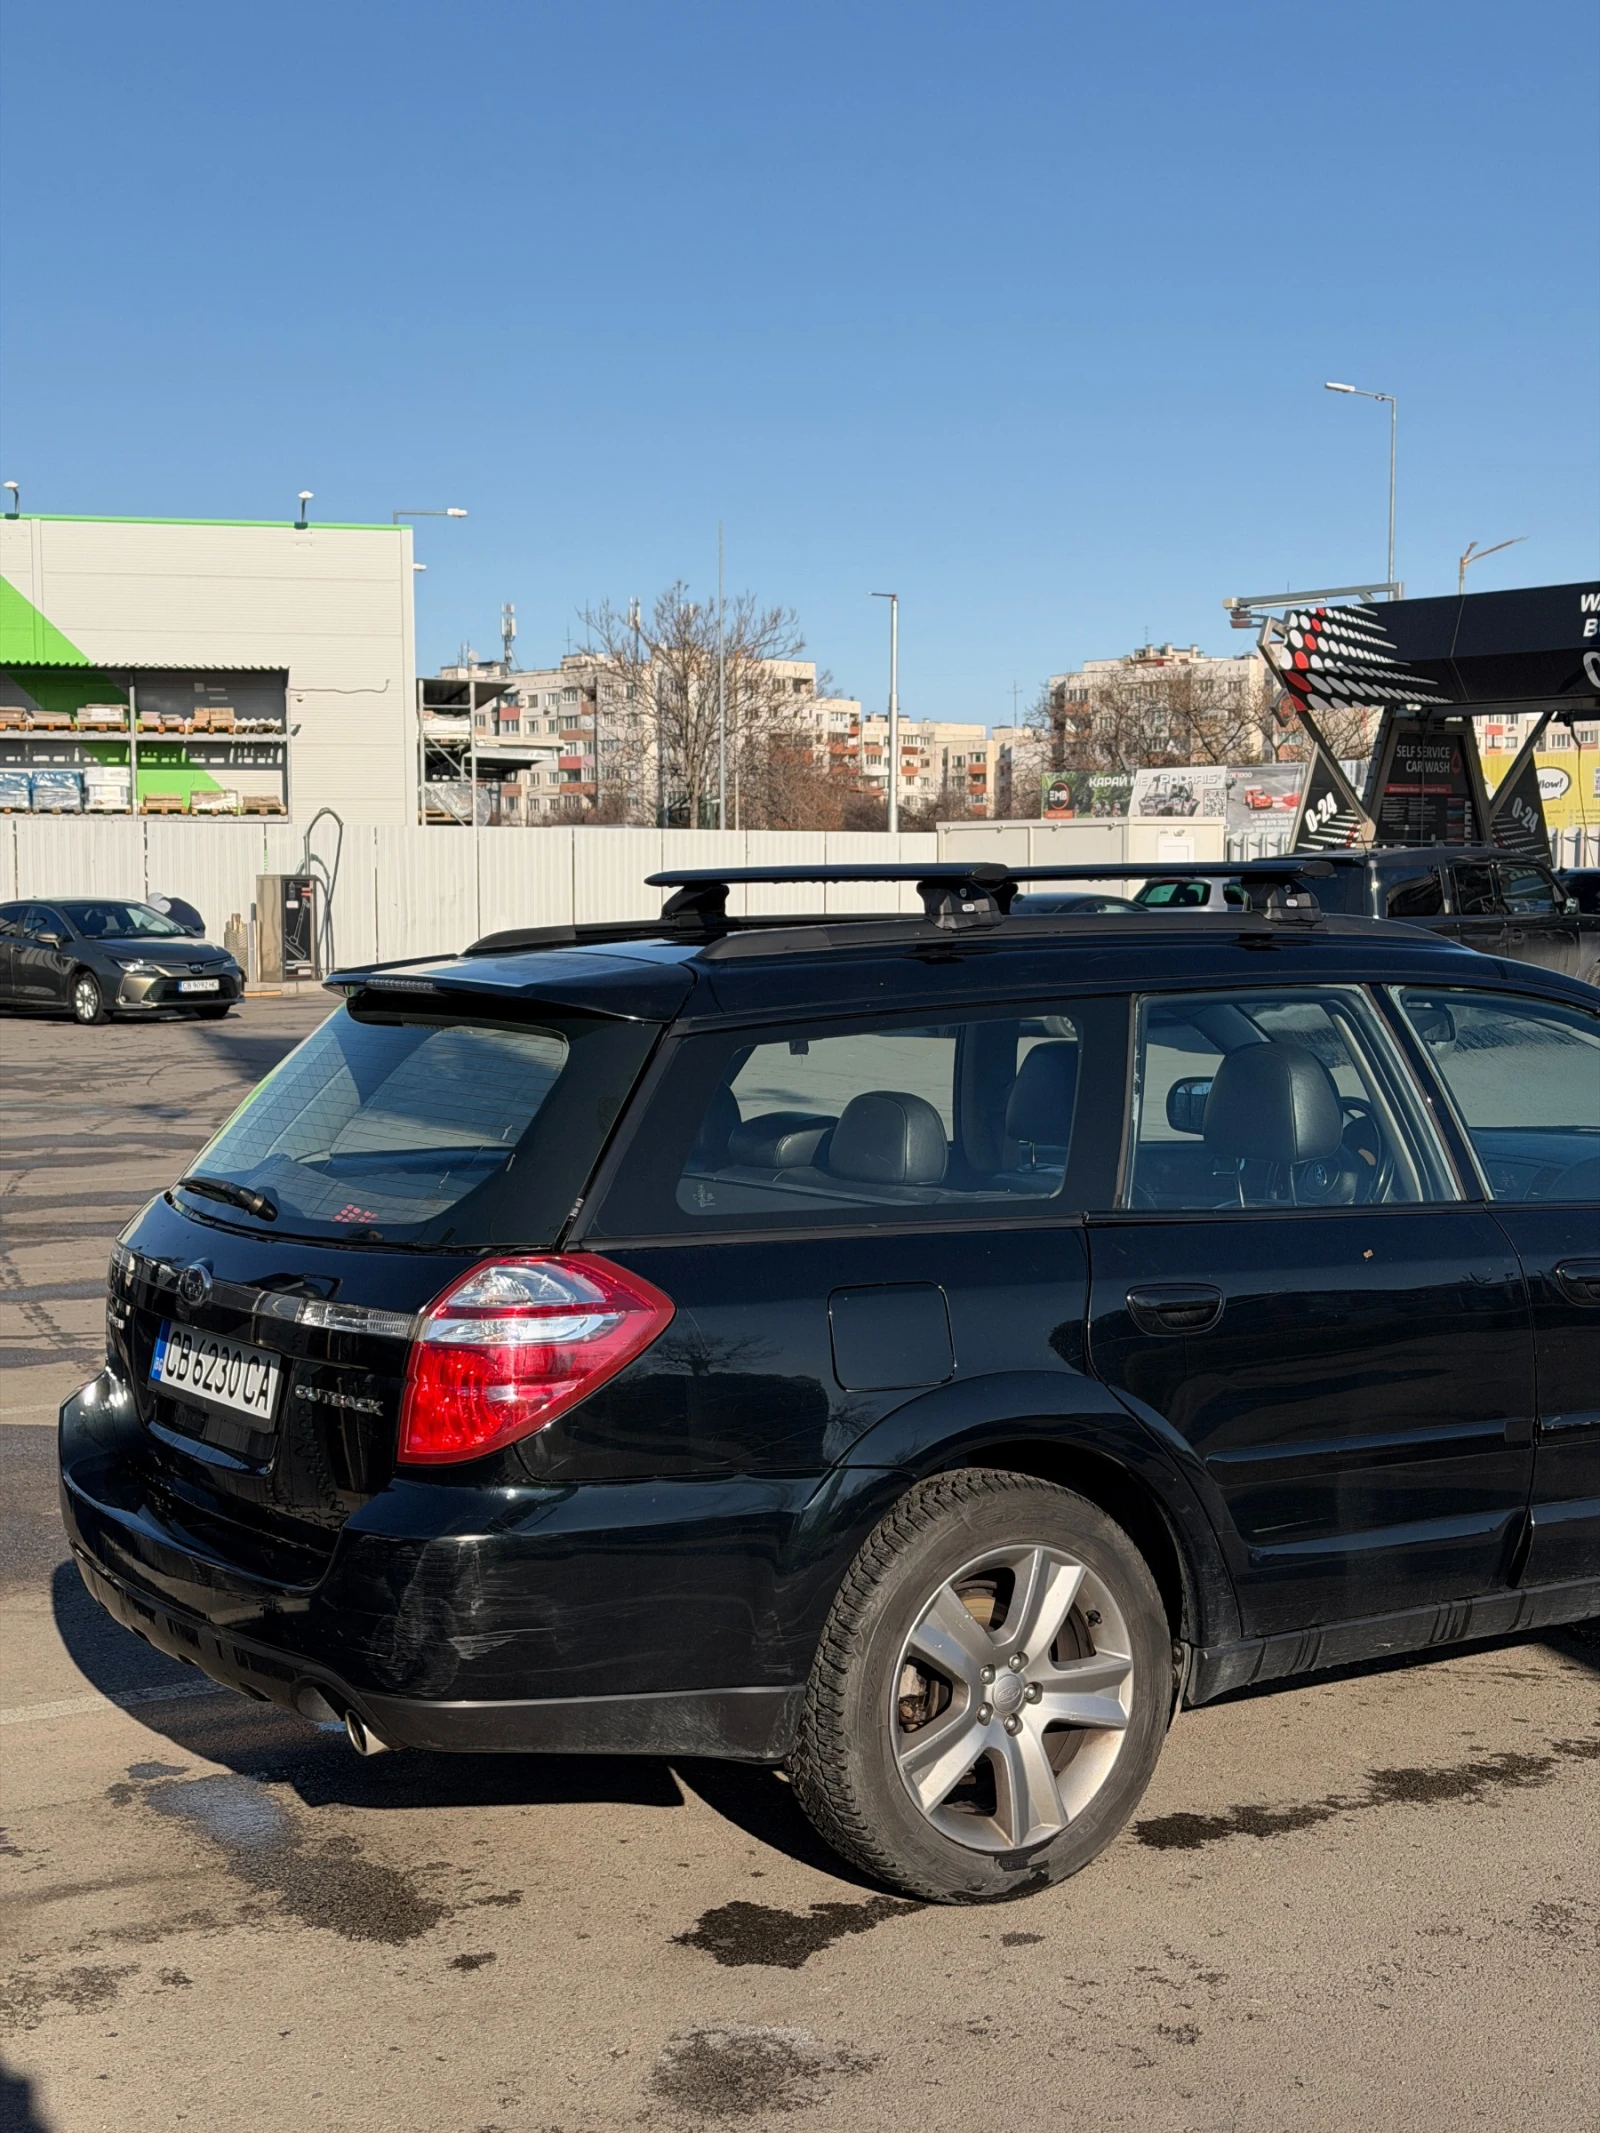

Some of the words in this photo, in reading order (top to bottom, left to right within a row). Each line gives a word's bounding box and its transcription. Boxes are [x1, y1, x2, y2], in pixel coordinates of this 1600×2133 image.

[1583, 618, 1600, 637] B
[1396, 745, 1415, 758] SELF
[1417, 746, 1450, 759] SERVICE
[1406, 760, 1423, 773] CAR
[1425, 761, 1450, 773] WASH
[1089, 774, 1128, 787] КАРАЙ
[1159, 774, 1218, 785] POLARIS
[1305, 791, 1337, 833] 0-24
[1512, 797, 1539, 833] 0-24
[295, 1384, 385, 1416] OUTBACK
